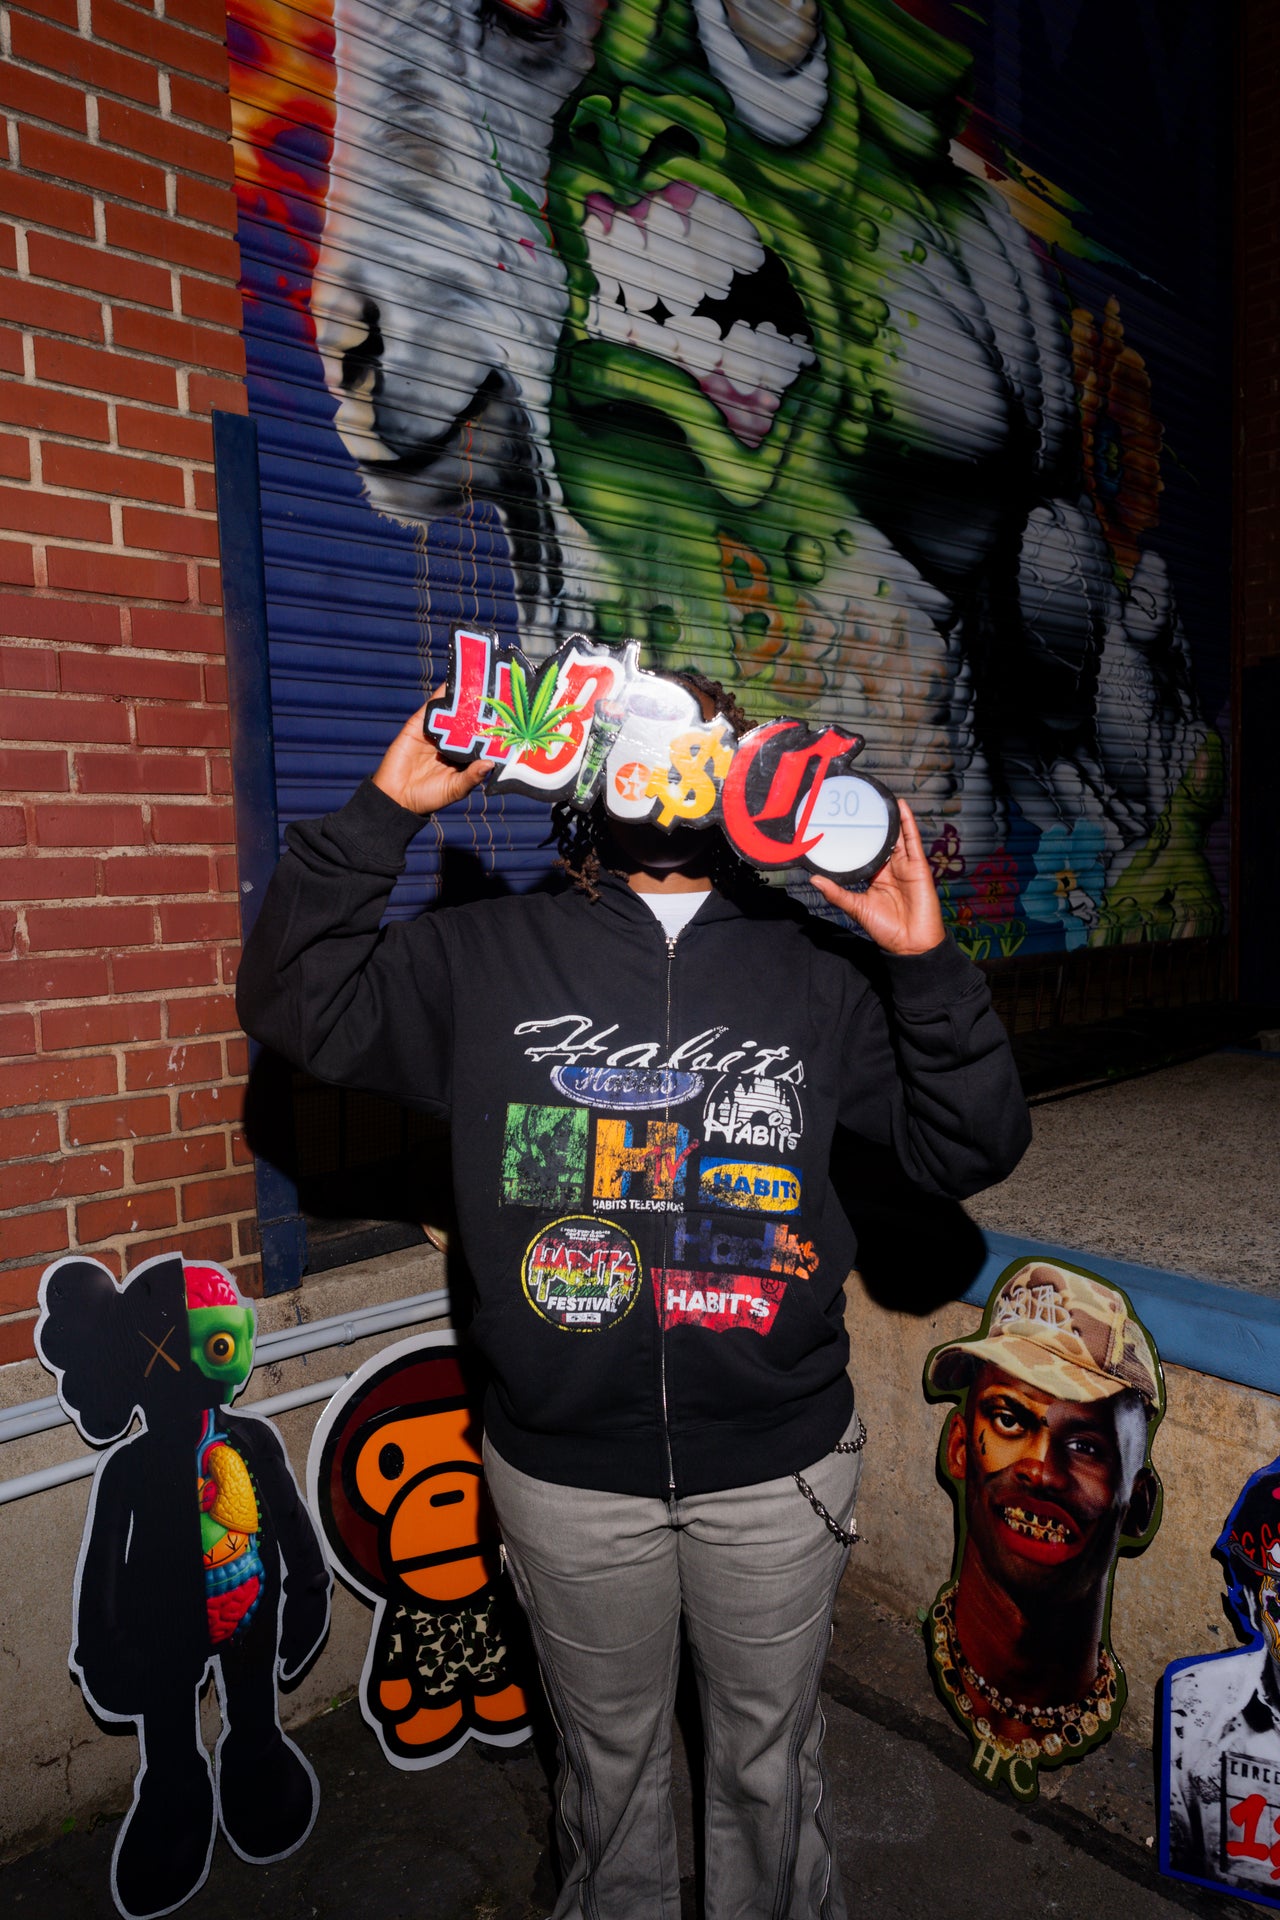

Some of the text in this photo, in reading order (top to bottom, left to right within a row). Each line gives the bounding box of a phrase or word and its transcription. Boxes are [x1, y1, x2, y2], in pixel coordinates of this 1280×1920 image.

[826, 789, 860, 818] 30
[513, 1014, 805, 1085] Habits
[713, 1172, 798, 1200] HABITS
[592, 1199, 685, 1213] HABITS TELEVISION
[547, 1296, 618, 1313] FESTIVAL
[666, 1287, 770, 1319] HABIT'S
